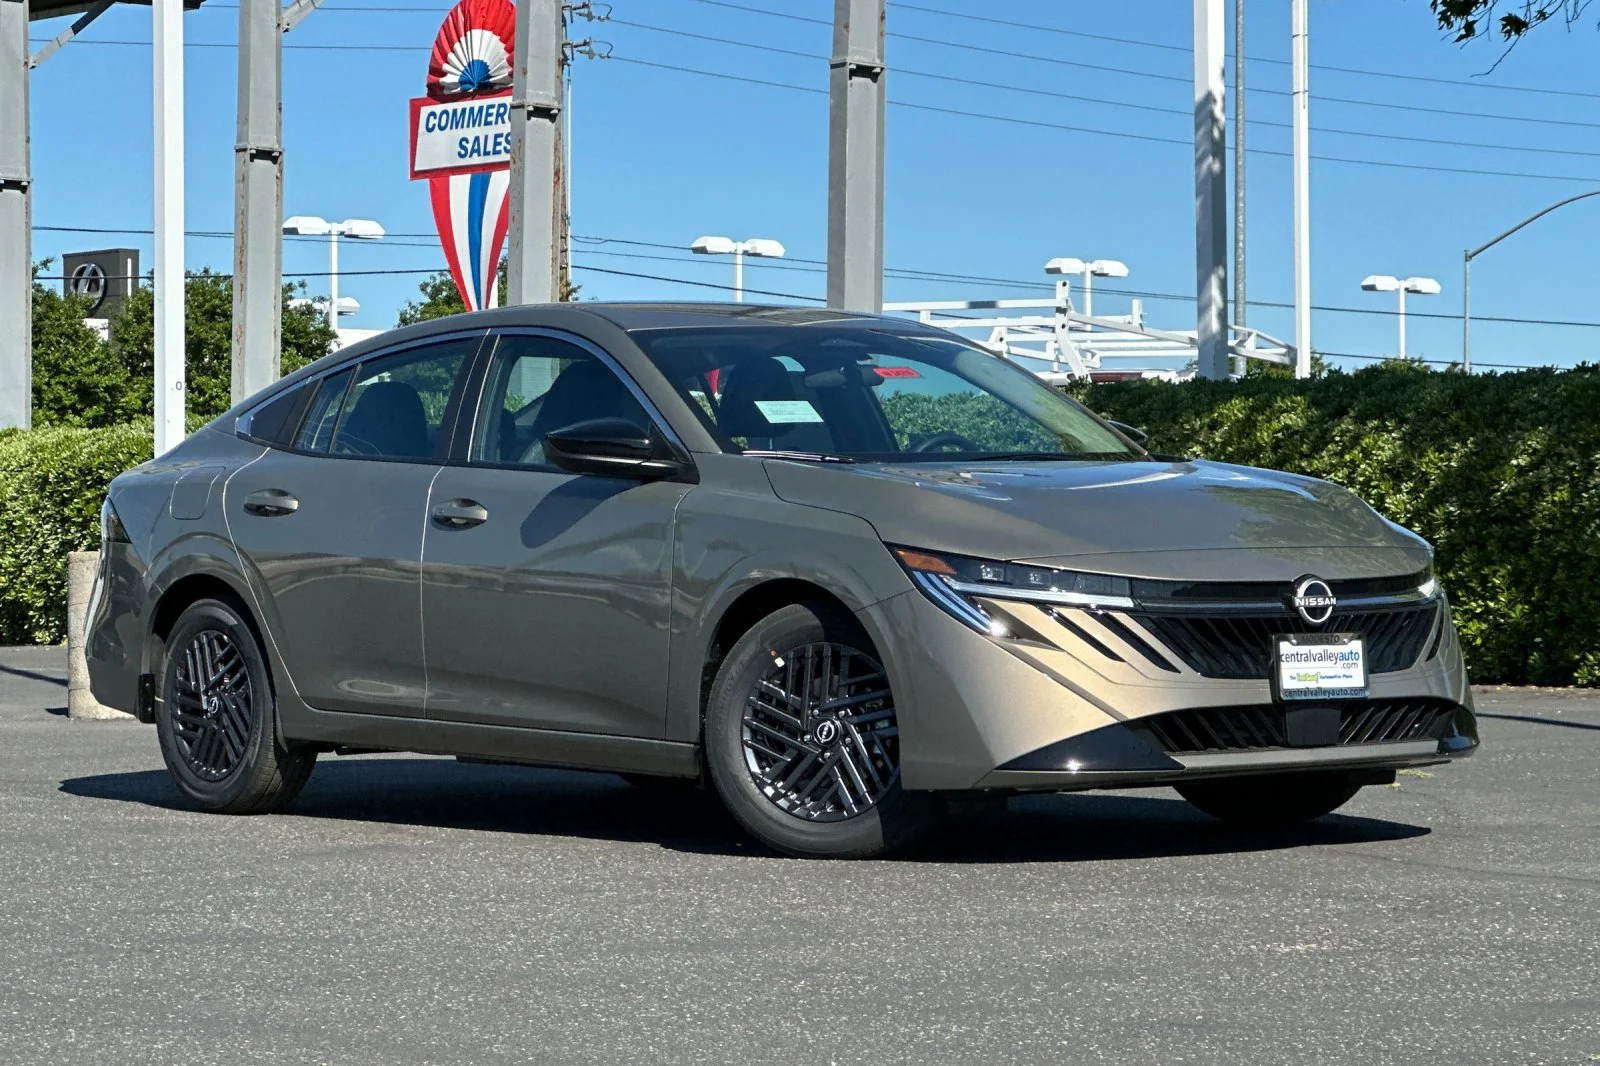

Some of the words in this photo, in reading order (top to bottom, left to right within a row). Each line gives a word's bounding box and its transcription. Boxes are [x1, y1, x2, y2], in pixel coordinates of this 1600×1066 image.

[425, 103, 511, 134] COMMER
[457, 132, 511, 158] SALES
[1296, 597, 1336, 606] NISSAN
[1302, 634, 1340, 644] MODESTO
[1281, 649, 1360, 665] centralvalleyauto
[1341, 662, 1359, 670] .com
[1284, 687, 1366, 698] centralvalleyauto.com
